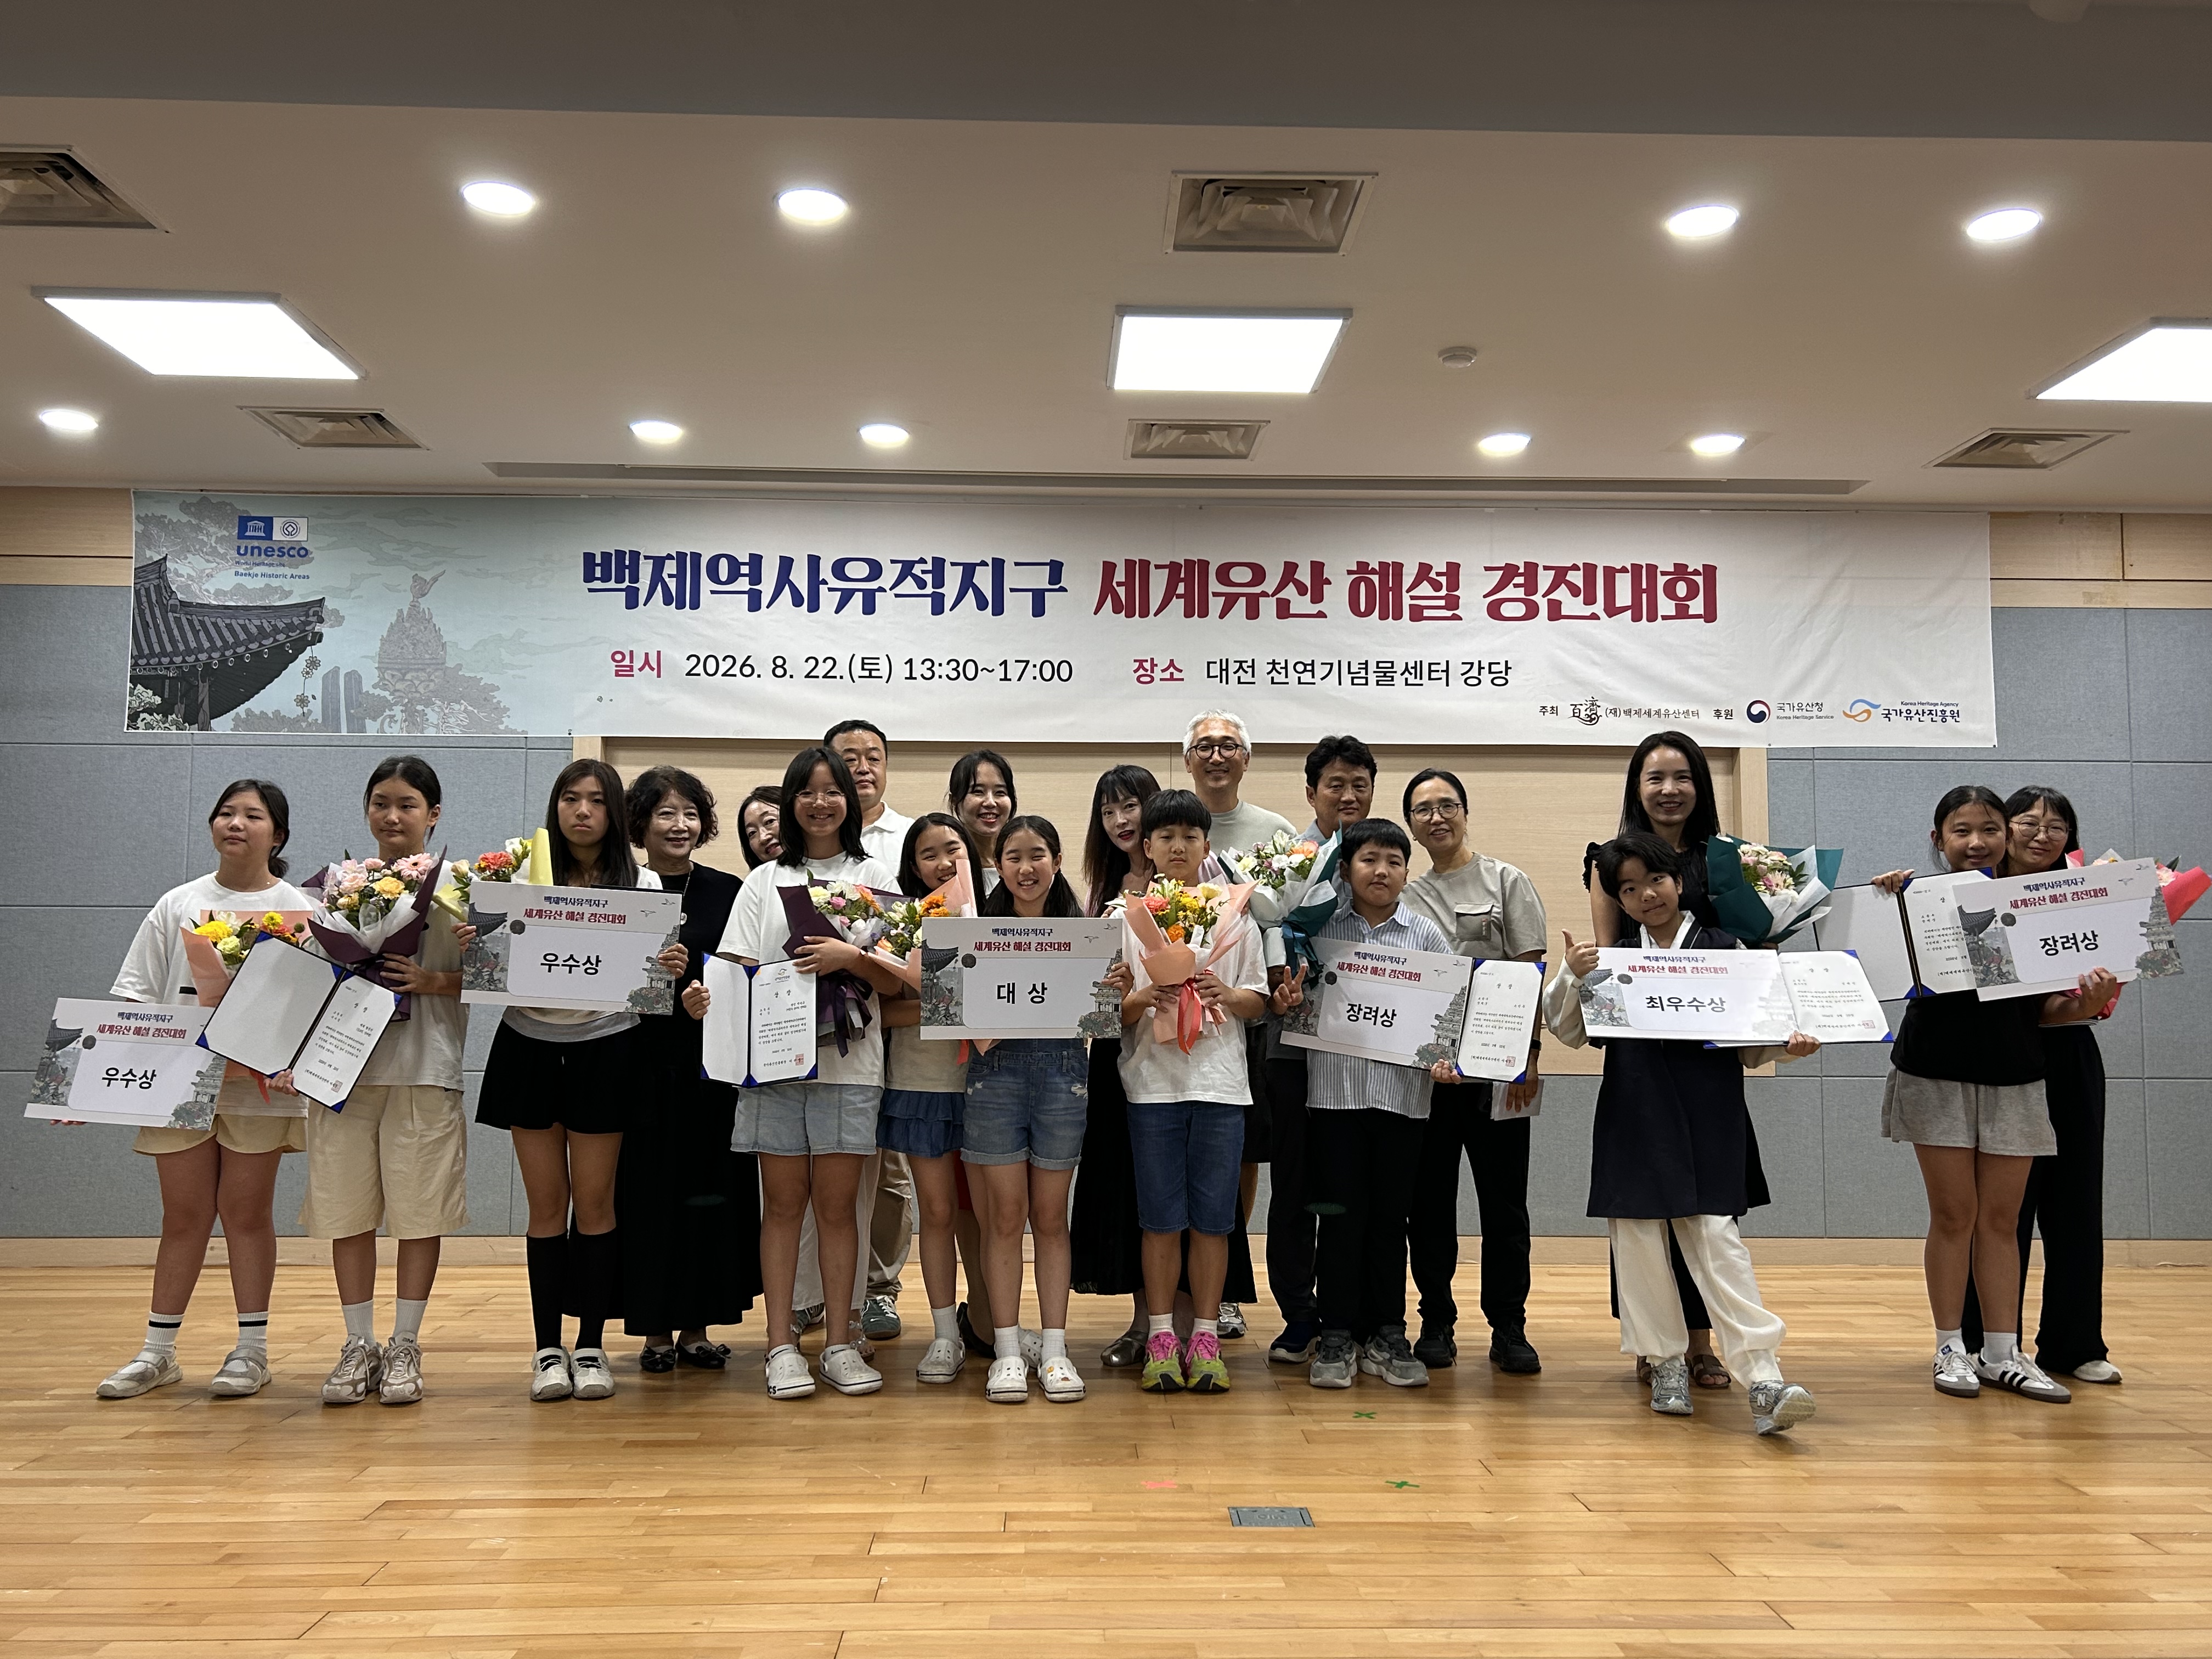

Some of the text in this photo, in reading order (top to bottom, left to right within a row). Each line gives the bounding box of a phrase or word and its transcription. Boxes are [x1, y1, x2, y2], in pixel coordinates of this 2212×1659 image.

[236, 545, 309, 558] unesco
[234, 571, 259, 579] Baekje
[582, 549, 1718, 624] 백제역사유적지구 세계유산 해설 경진대회
[611, 650, 662, 679] 일시
[685, 654, 761, 678] 2026.
[771, 656, 794, 679] 8.
[904, 658, 1073, 682] 13:30~17:00
[1132, 657, 1513, 687] 장소 대전 천연기념물센터 강당
[1539, 706, 1558, 716] 주최
[1713, 708, 1734, 720] 후원
[1776, 702, 1824, 712] 국가유산청
[1881, 708, 1960, 723] 국가유산진흥원
[2010, 887, 2108, 909] 세계유산 해설 경진대회
[523, 908, 627, 924] 세계유산 해설 경진대회
[973, 941, 1071, 952] 세계유산 해설 경진대회
[2039, 930, 2100, 957] 장려상
[540, 952, 602, 975] 우수상
[1336, 961, 1421, 982] 세계유산 해설 경진대회
[1628, 965, 1729, 974] 세계유산 해설 경진대회
[1645, 995, 1726, 1013] 최우수상
[1346, 1002, 1398, 1028] 장려상
[97, 1024, 187, 1039] 세계유산 해설 경진대회
[101, 1066, 157, 1090] 우수상
